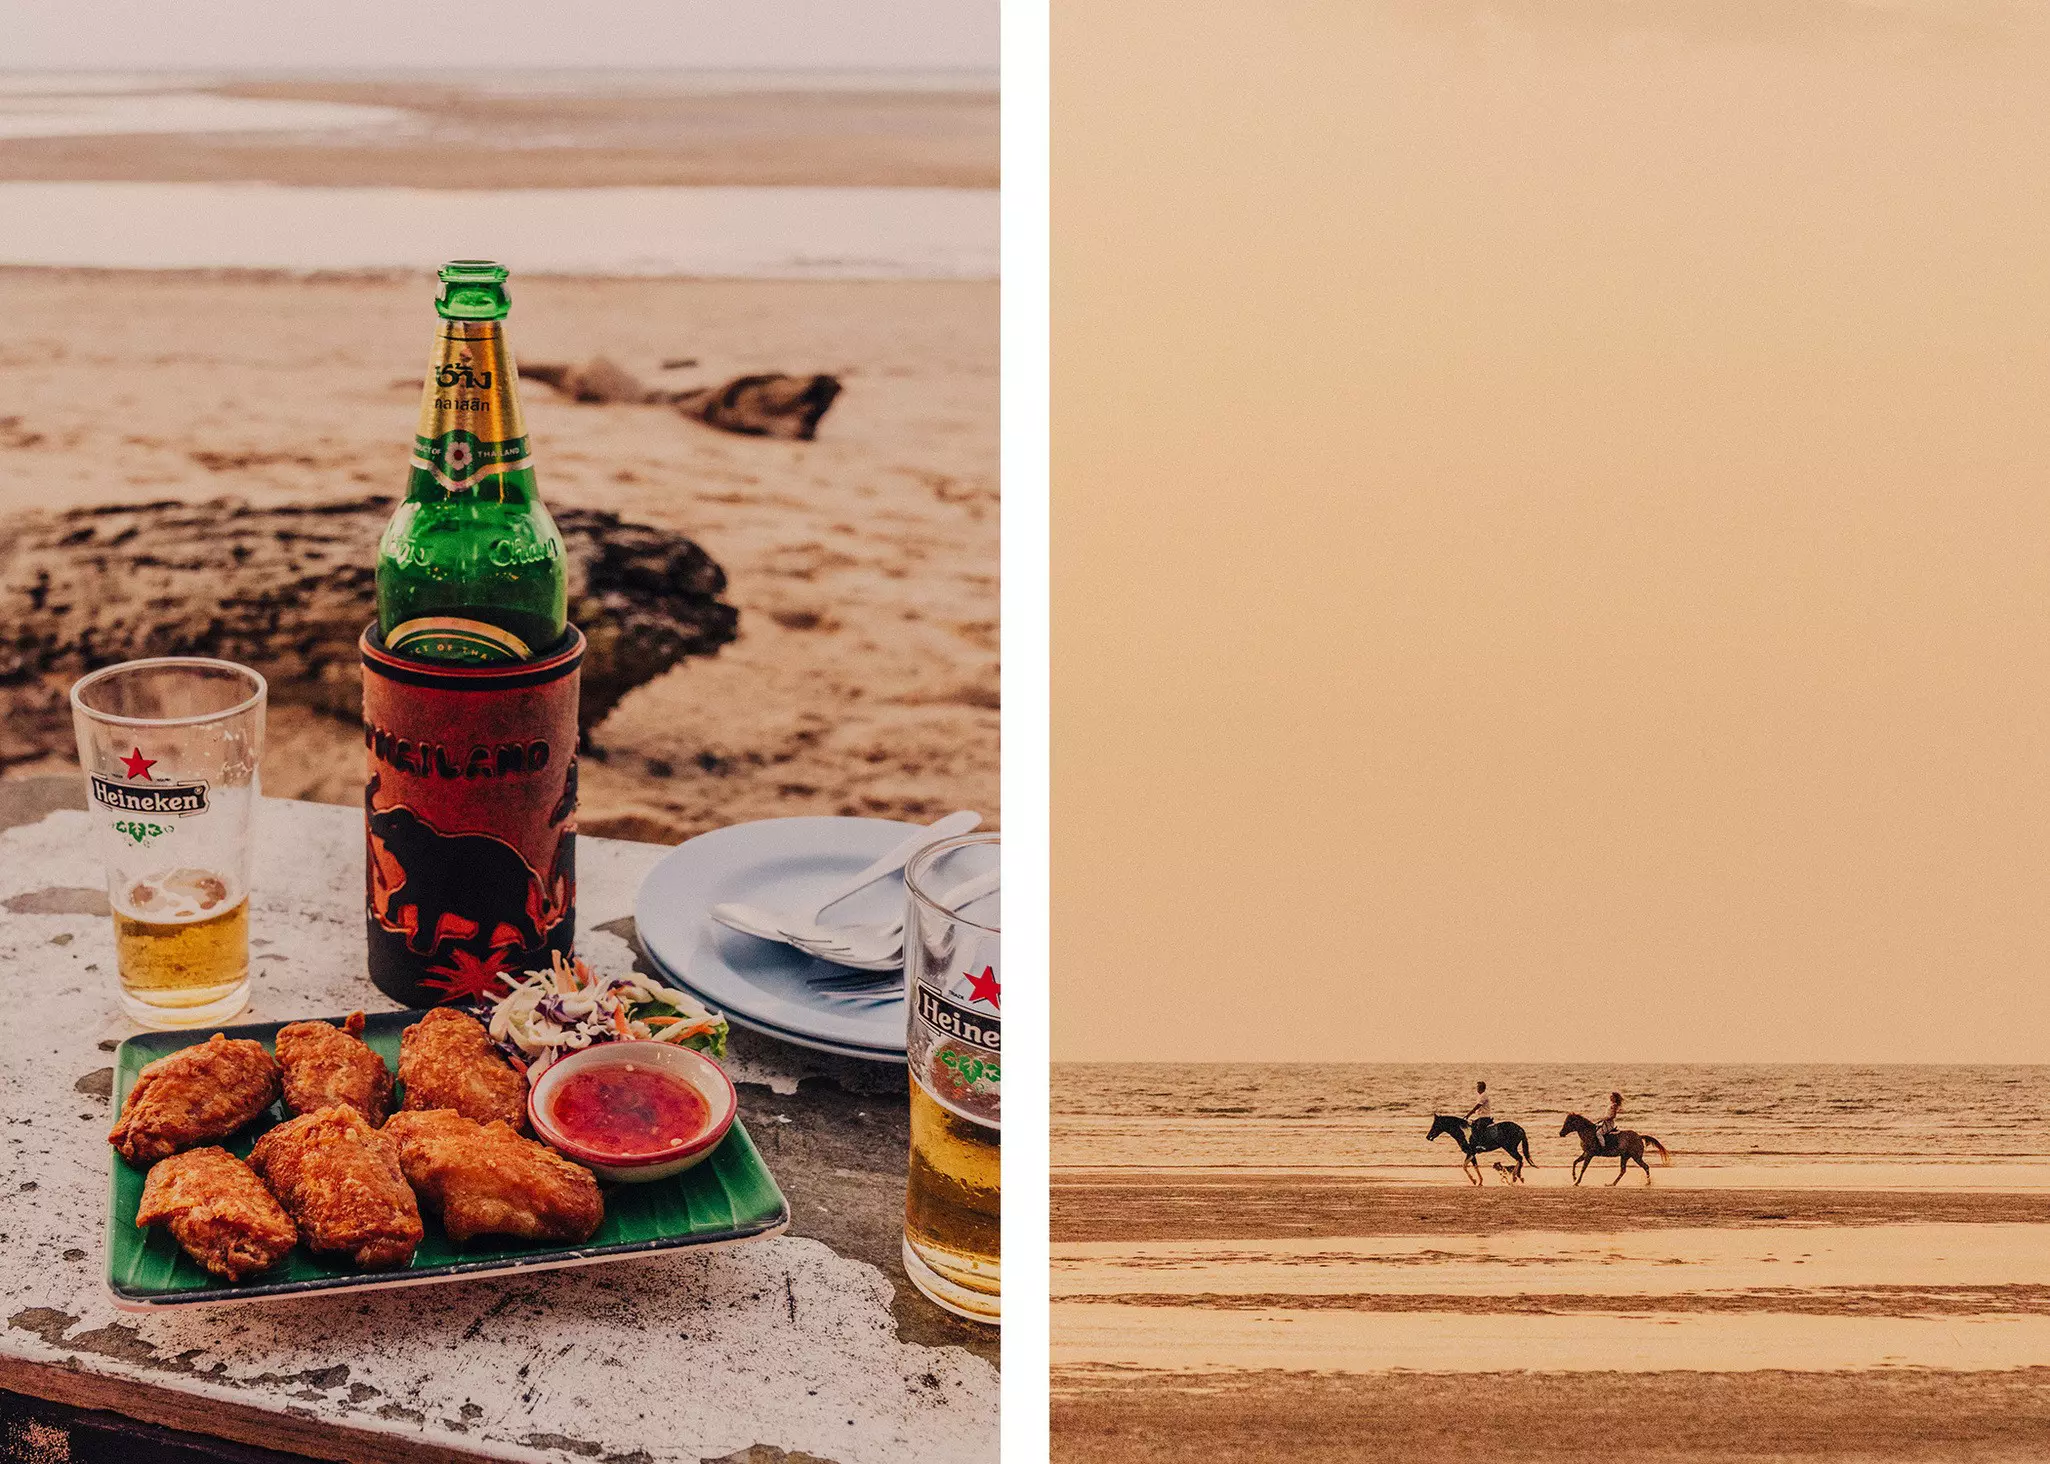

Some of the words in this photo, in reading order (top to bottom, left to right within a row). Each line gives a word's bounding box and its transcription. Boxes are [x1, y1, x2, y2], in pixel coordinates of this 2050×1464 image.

[435, 363, 492, 389] ช้าง
[435, 397, 490, 411] คลาสสิก
[94, 779, 200, 812] Heineken
